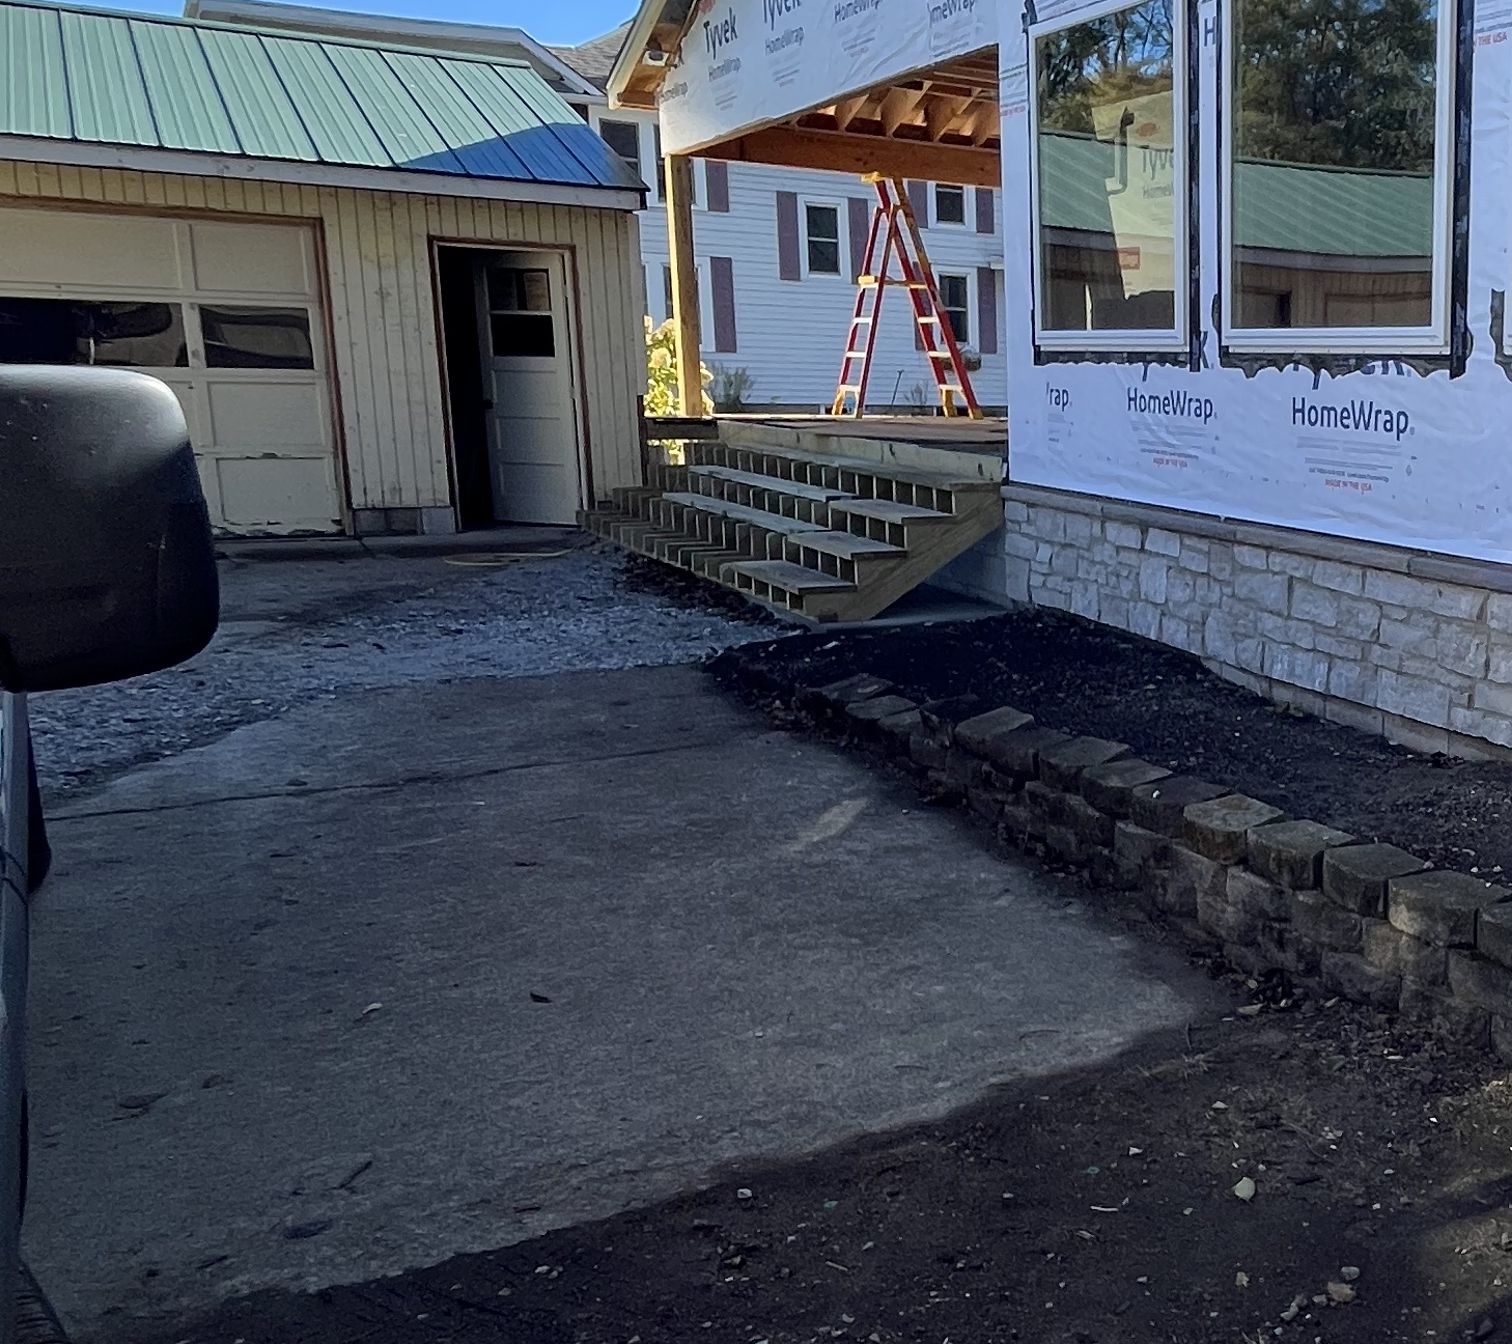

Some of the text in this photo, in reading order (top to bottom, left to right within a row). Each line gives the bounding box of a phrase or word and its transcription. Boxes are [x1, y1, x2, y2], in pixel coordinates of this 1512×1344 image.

[703, 7, 738, 60] Tyvek
[1127, 387, 1213, 425] HomeWrap
[1292, 397, 1409, 441] HomeWrap
